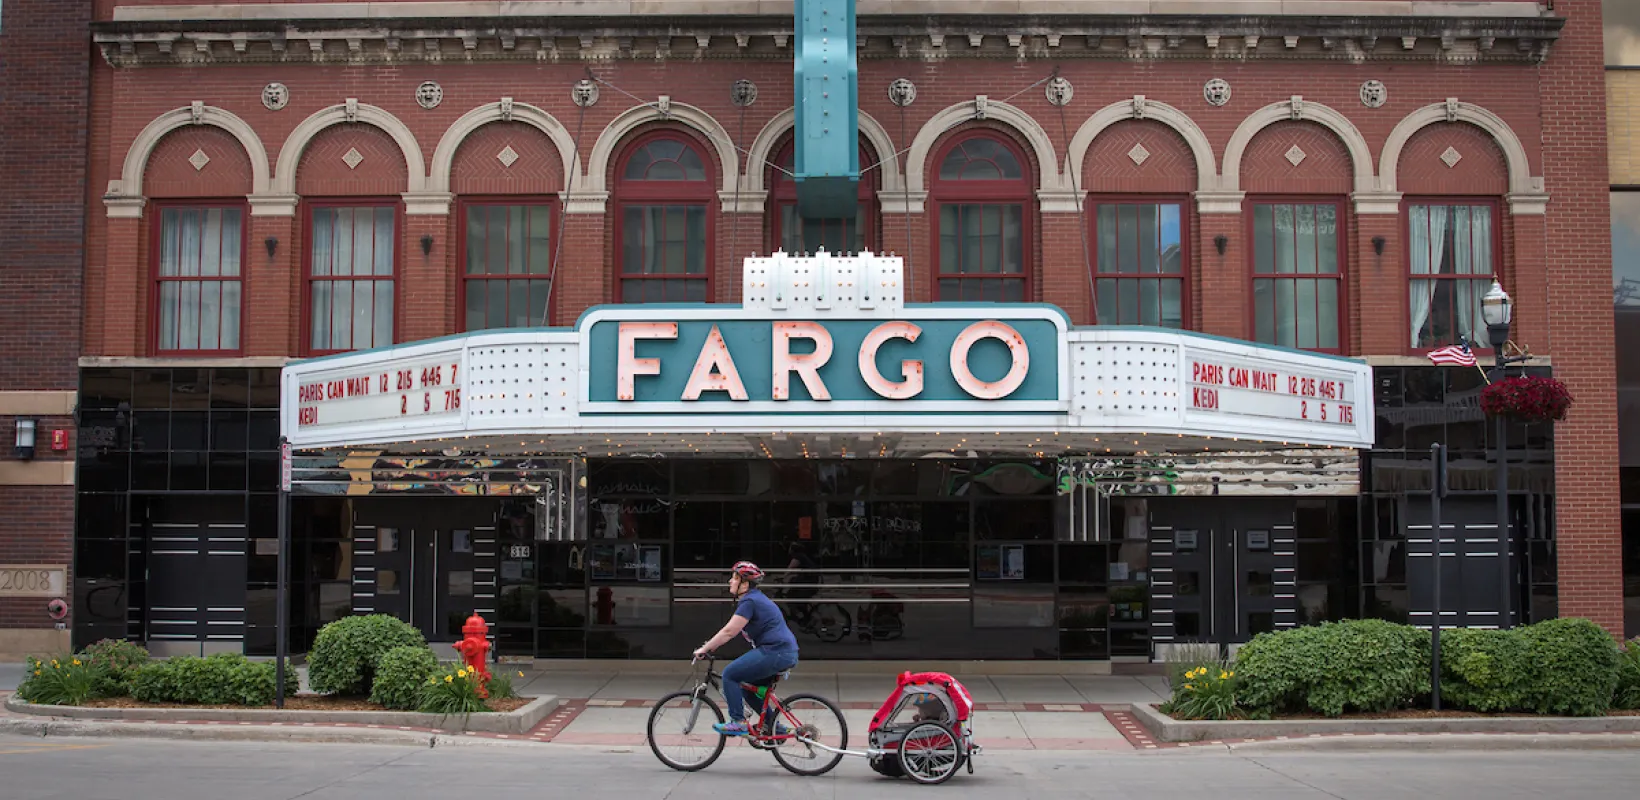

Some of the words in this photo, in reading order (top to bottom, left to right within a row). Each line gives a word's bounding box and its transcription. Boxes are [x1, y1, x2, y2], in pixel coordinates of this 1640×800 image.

[617, 318, 1030, 402] FARGO
[299, 385, 323, 403] PARIS
[327, 380, 344, 400] CAN
[346, 376, 370, 397] WAIT
[380, 374, 389, 393] 12
[397, 370, 412, 390] 215
[421, 366, 441, 387] 445
[451, 364, 457, 384] 7
[1193, 362, 1223, 384] PARIS
[1228, 366, 1249, 389] CAN
[1252, 370, 1278, 392] WAIT
[1288, 375, 1298, 395] 12
[1301, 377, 1316, 397] 215
[1318, 380, 1336, 400] 445
[1338, 381, 1344, 400] 7
[299, 407, 318, 425] KEDI
[401, 395, 407, 415] 2
[423, 392, 430, 412] 5
[445, 389, 460, 410] 715
[1192, 387, 1219, 409] KEDI
[1301, 400, 1307, 419] 2
[1320, 403, 1326, 421] 5
[1339, 405, 1352, 423] 715
[512, 546, 529, 557] 314
[1, 570, 50, 590] 2008
